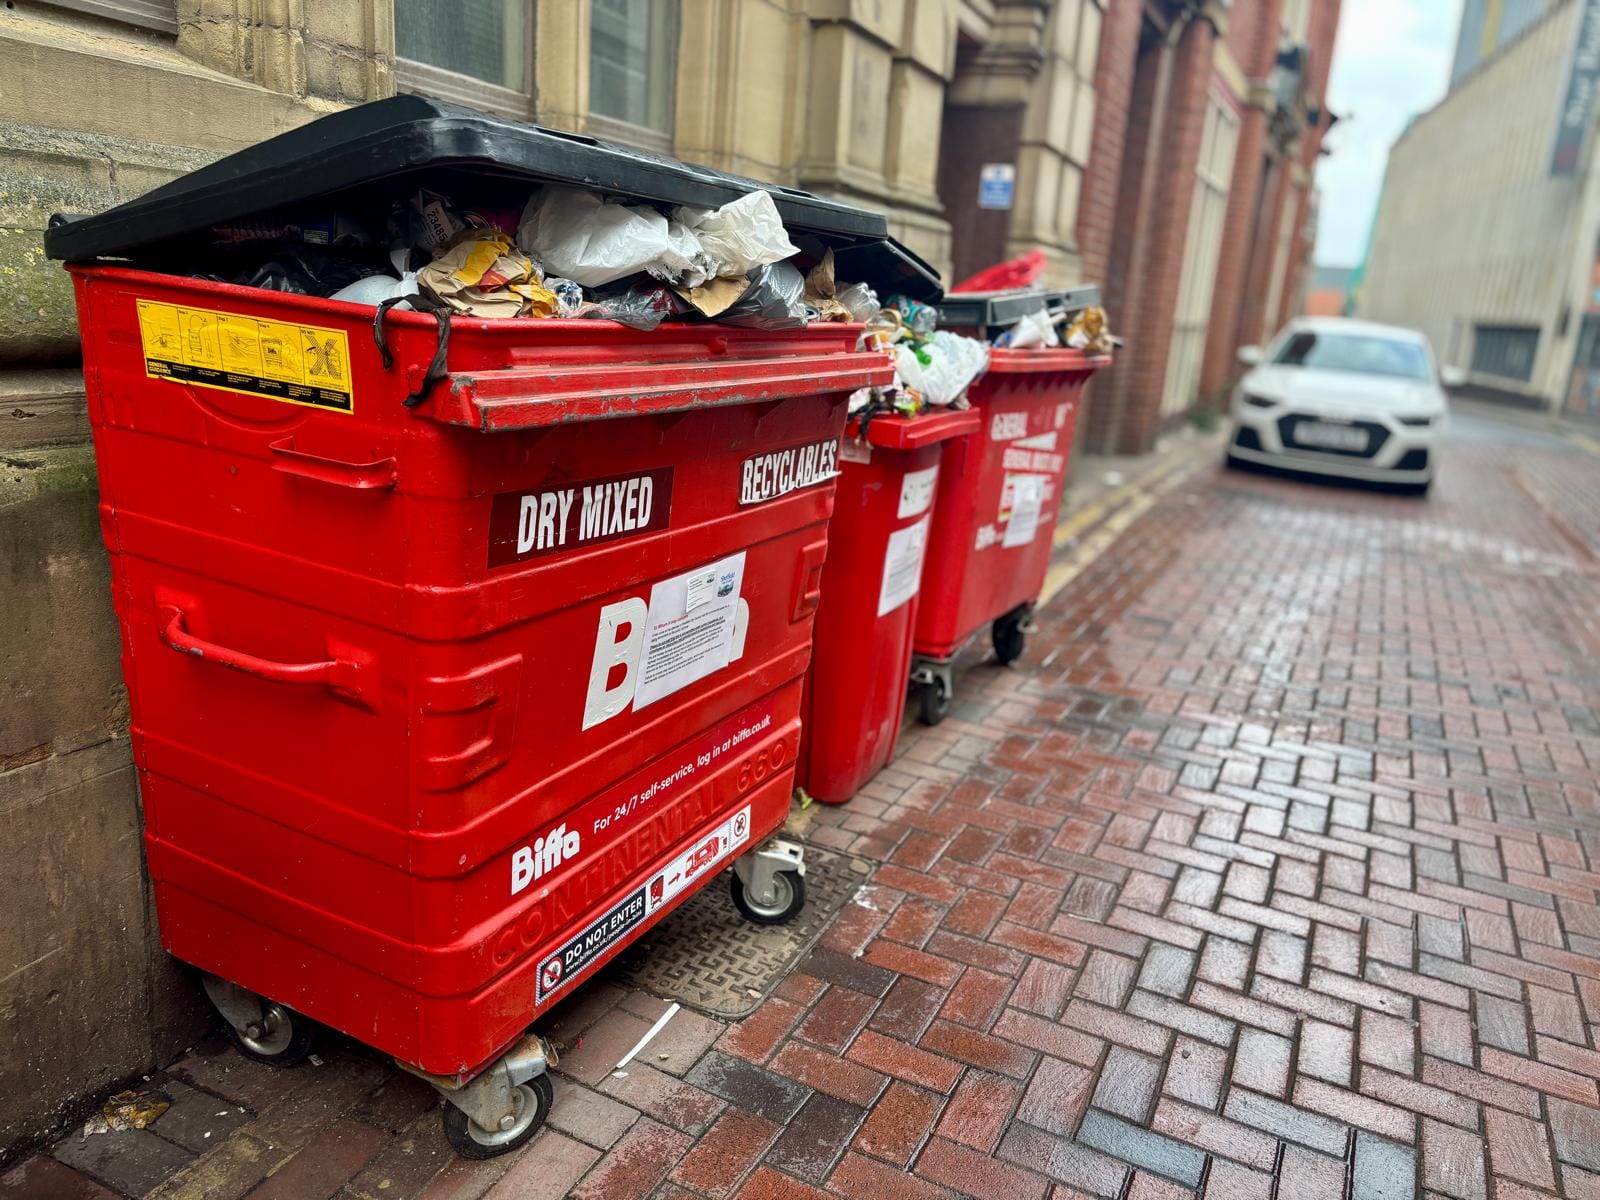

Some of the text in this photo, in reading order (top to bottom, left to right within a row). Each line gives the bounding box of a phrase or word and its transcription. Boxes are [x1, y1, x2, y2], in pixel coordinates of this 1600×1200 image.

[427, 210, 449, 242] 23485
[741, 439, 838, 504] RECYCLABLES
[516, 476, 654, 554] DRY MIXED
[593, 714, 772, 834] For 24/7 self-service, log in at biffa.co.uk
[491, 737, 788, 970] CONTINENTAL 660
[511, 822, 580, 896] Biffa
[565, 896, 643, 966] DO NOT ENTER
